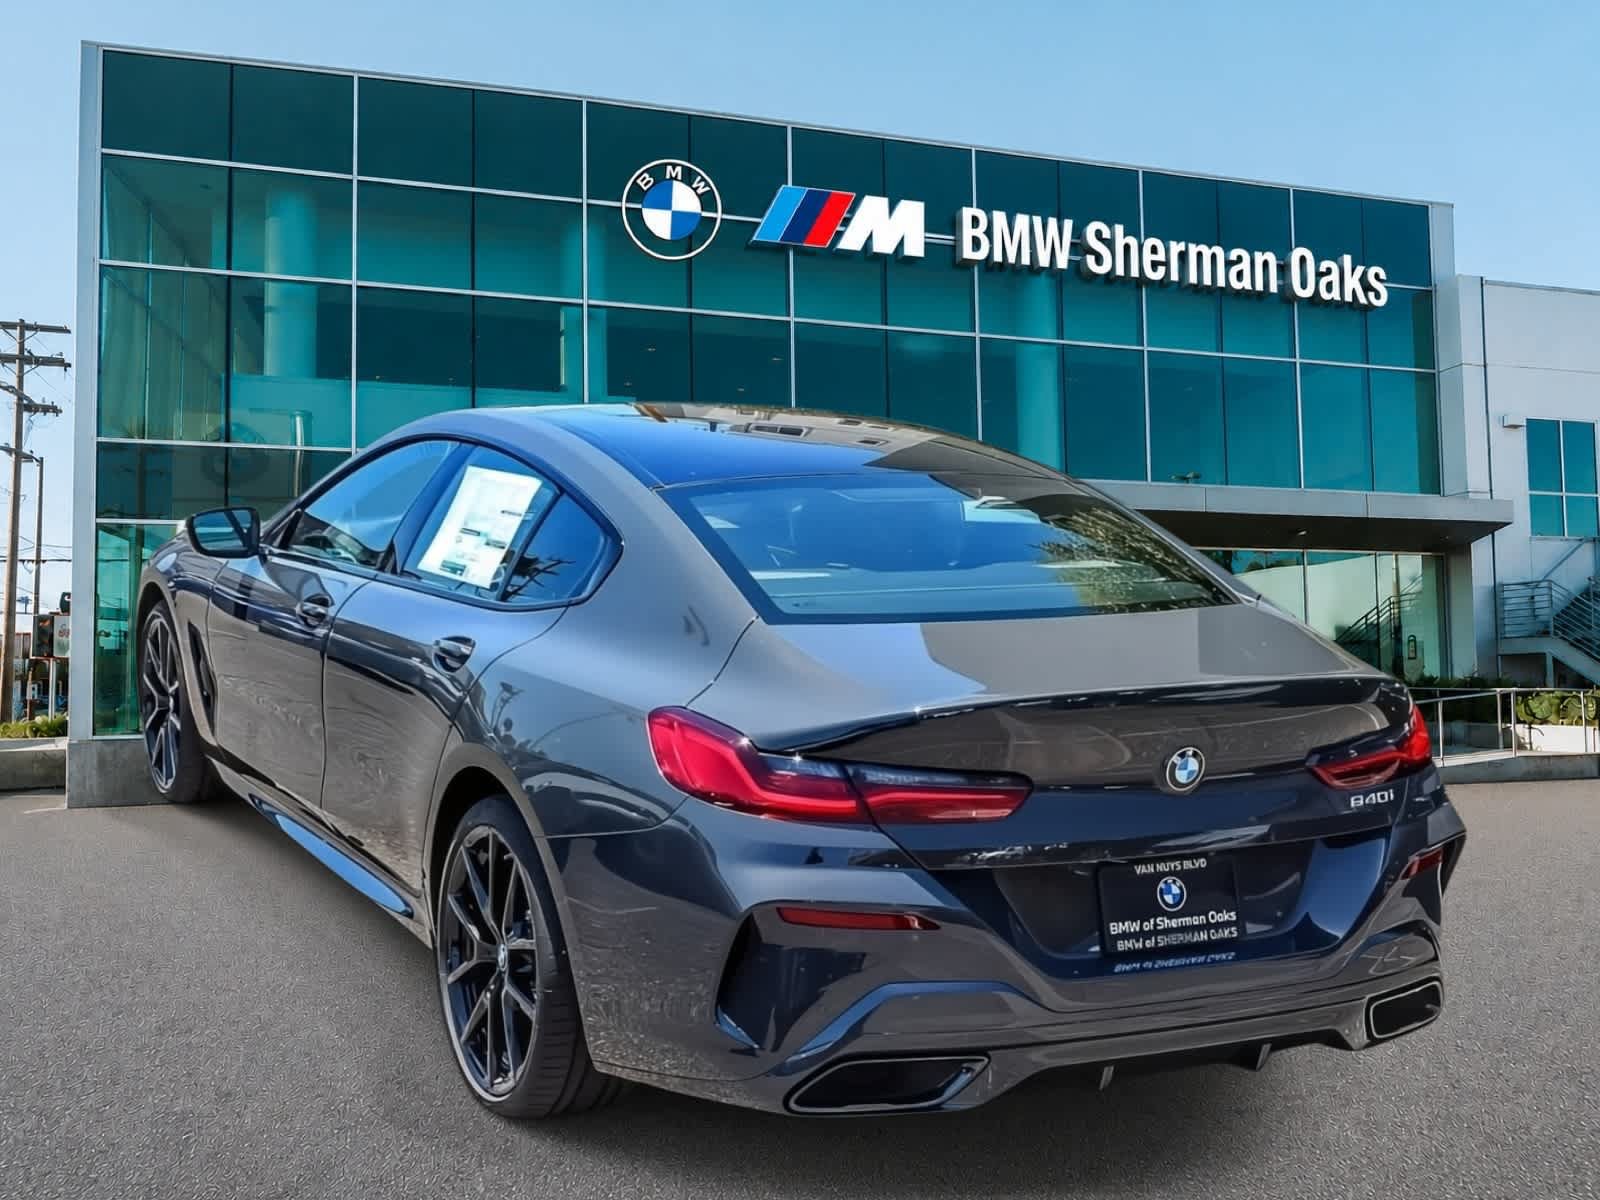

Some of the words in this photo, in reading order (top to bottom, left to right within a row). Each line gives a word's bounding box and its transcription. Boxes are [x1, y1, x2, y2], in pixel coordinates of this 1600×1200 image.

[636, 164, 711, 195] BMW
[959, 206, 1074, 270] BMW
[1084, 220, 1279, 293] Sherman
[1288, 246, 1389, 308] Oaks
[1350, 788, 1395, 808] 840i
[1134, 863, 1155, 876] VAN
[1183, 858, 1208, 870] BLVD
[1109, 920, 1141, 935] BMW
[1143, 917, 1155, 932] of
[1156, 914, 1207, 930] Sherman
[1208, 910, 1237, 924] Oaks
[1117, 938, 1143, 951] BMW
[1145, 936, 1156, 948] of
[1157, 931, 1208, 947] SHERMAN
[1209, 927, 1238, 940] OAKS
